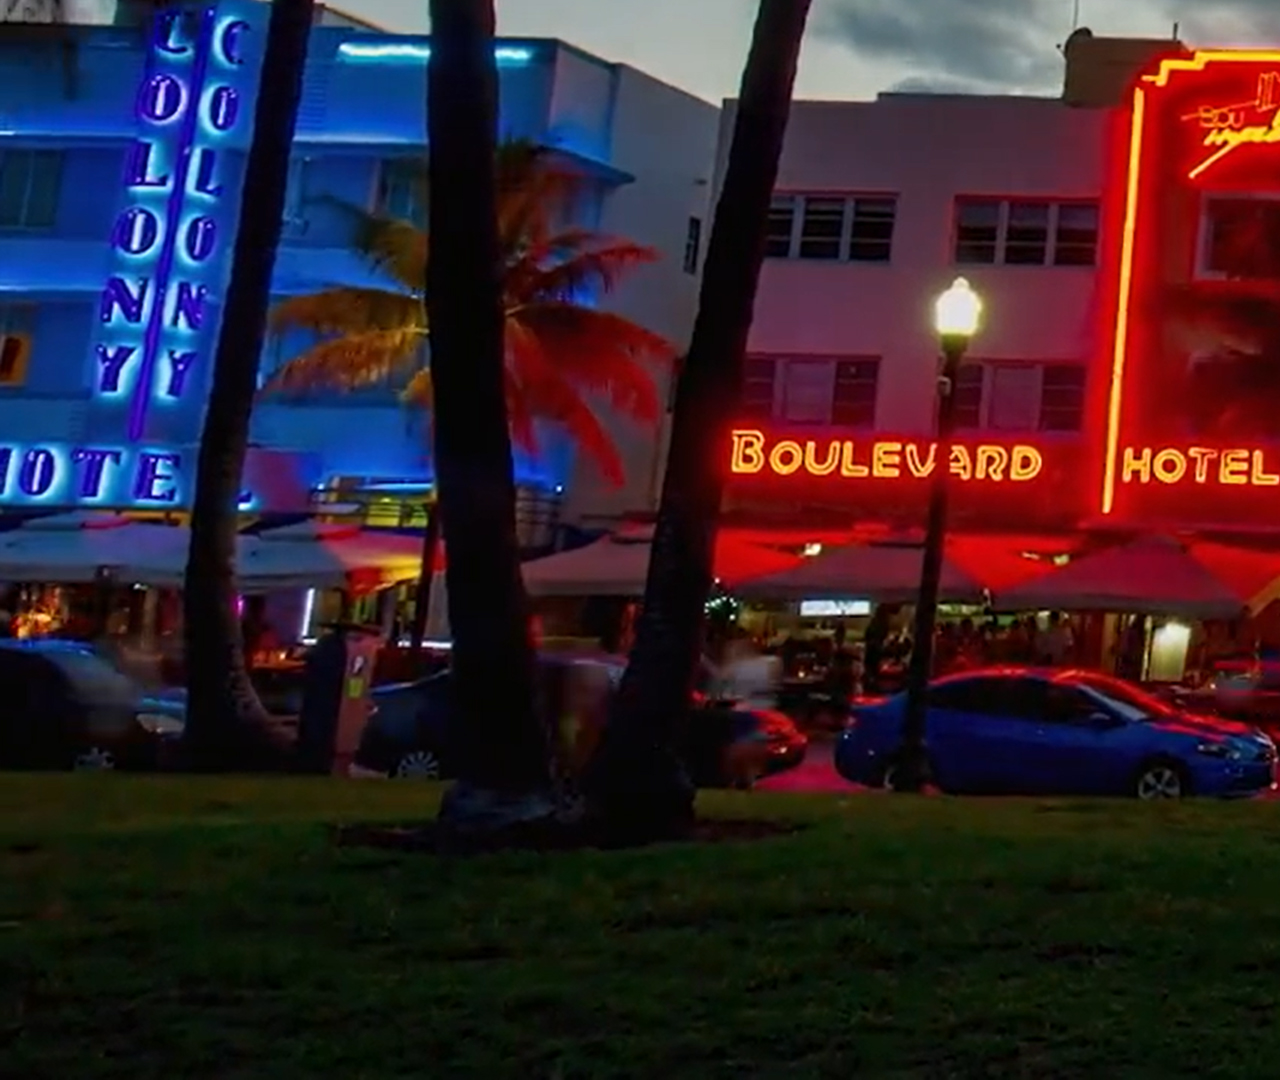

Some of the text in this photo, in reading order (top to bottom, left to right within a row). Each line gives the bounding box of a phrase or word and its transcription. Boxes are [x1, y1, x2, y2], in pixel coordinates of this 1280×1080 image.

[160, 18, 250, 398] COLONY
[0, 447, 254, 506] OTE
[732, 430, 1280, 485] BOULEVARD HOTEL
